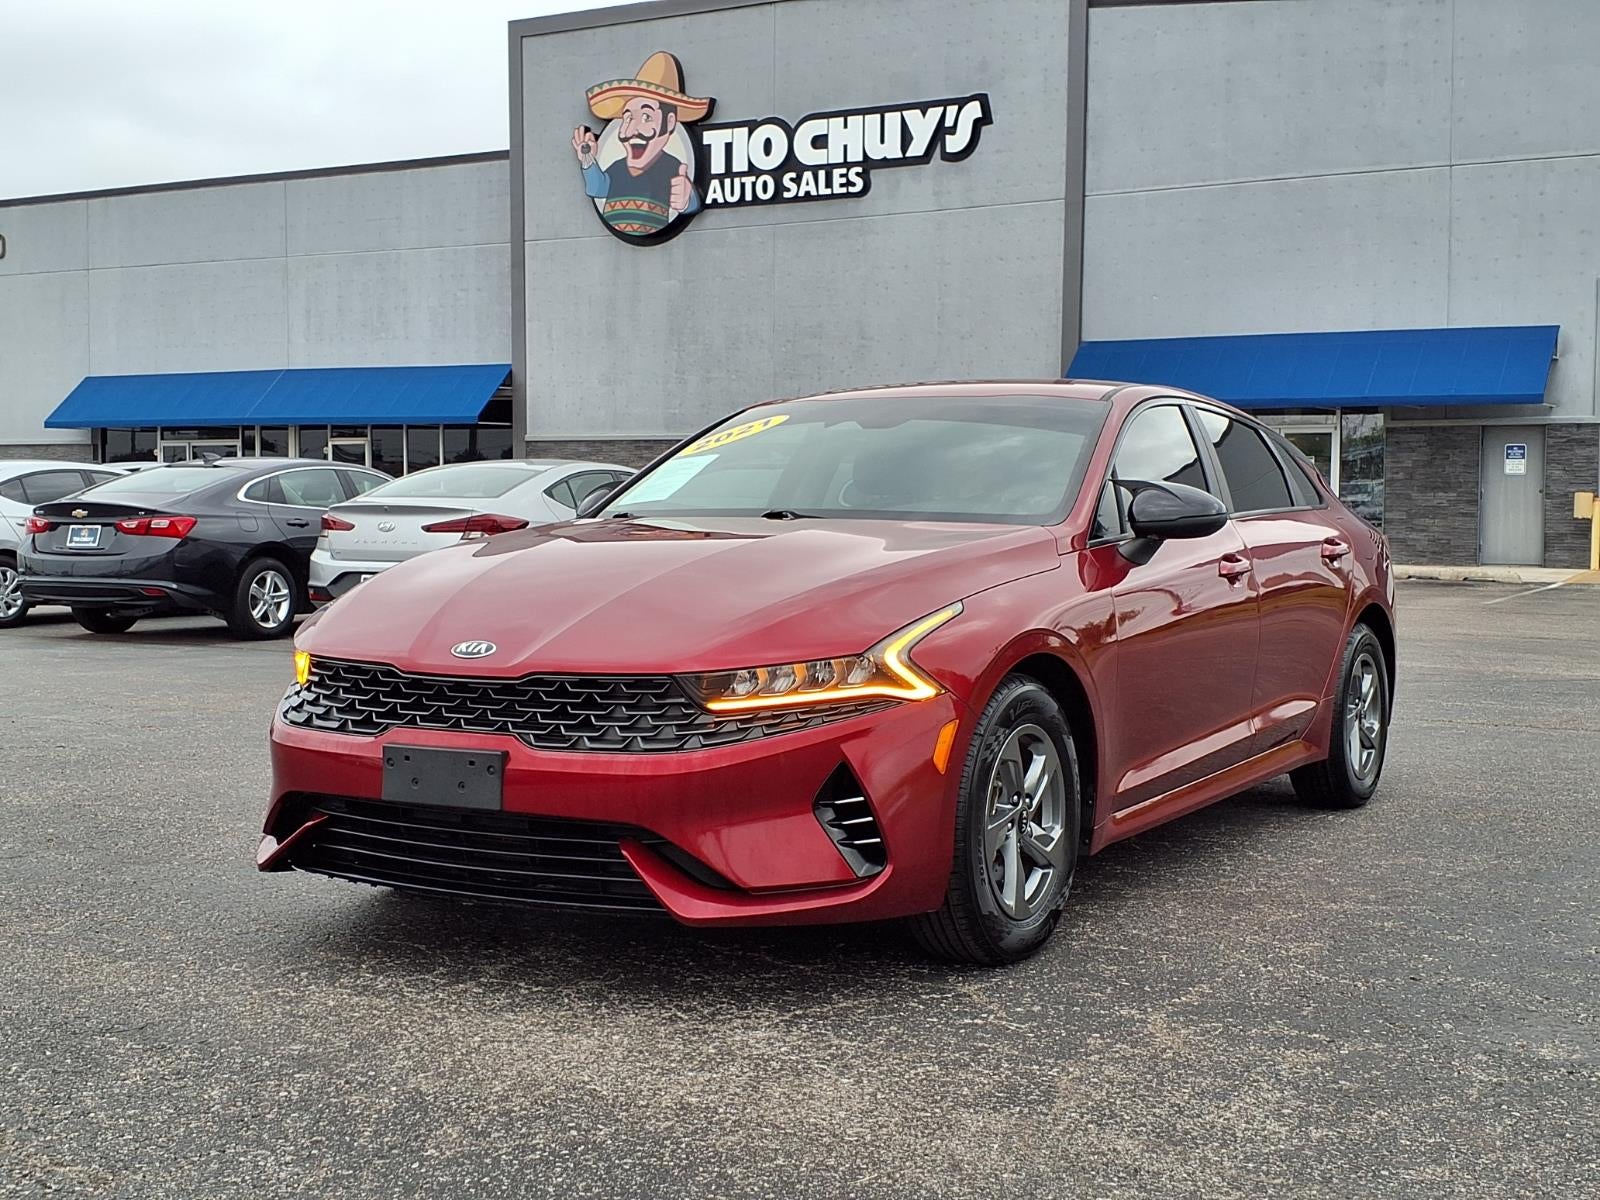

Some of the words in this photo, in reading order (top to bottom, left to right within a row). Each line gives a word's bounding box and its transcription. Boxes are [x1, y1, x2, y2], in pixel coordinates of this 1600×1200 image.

[702, 123, 788, 174] TIO
[793, 100, 982, 166] CHUY'S
[705, 174, 775, 204] AUTO
[782, 166, 864, 199] SALES
[694, 419, 772, 450] 2021
[455, 642, 488, 654] KIA
